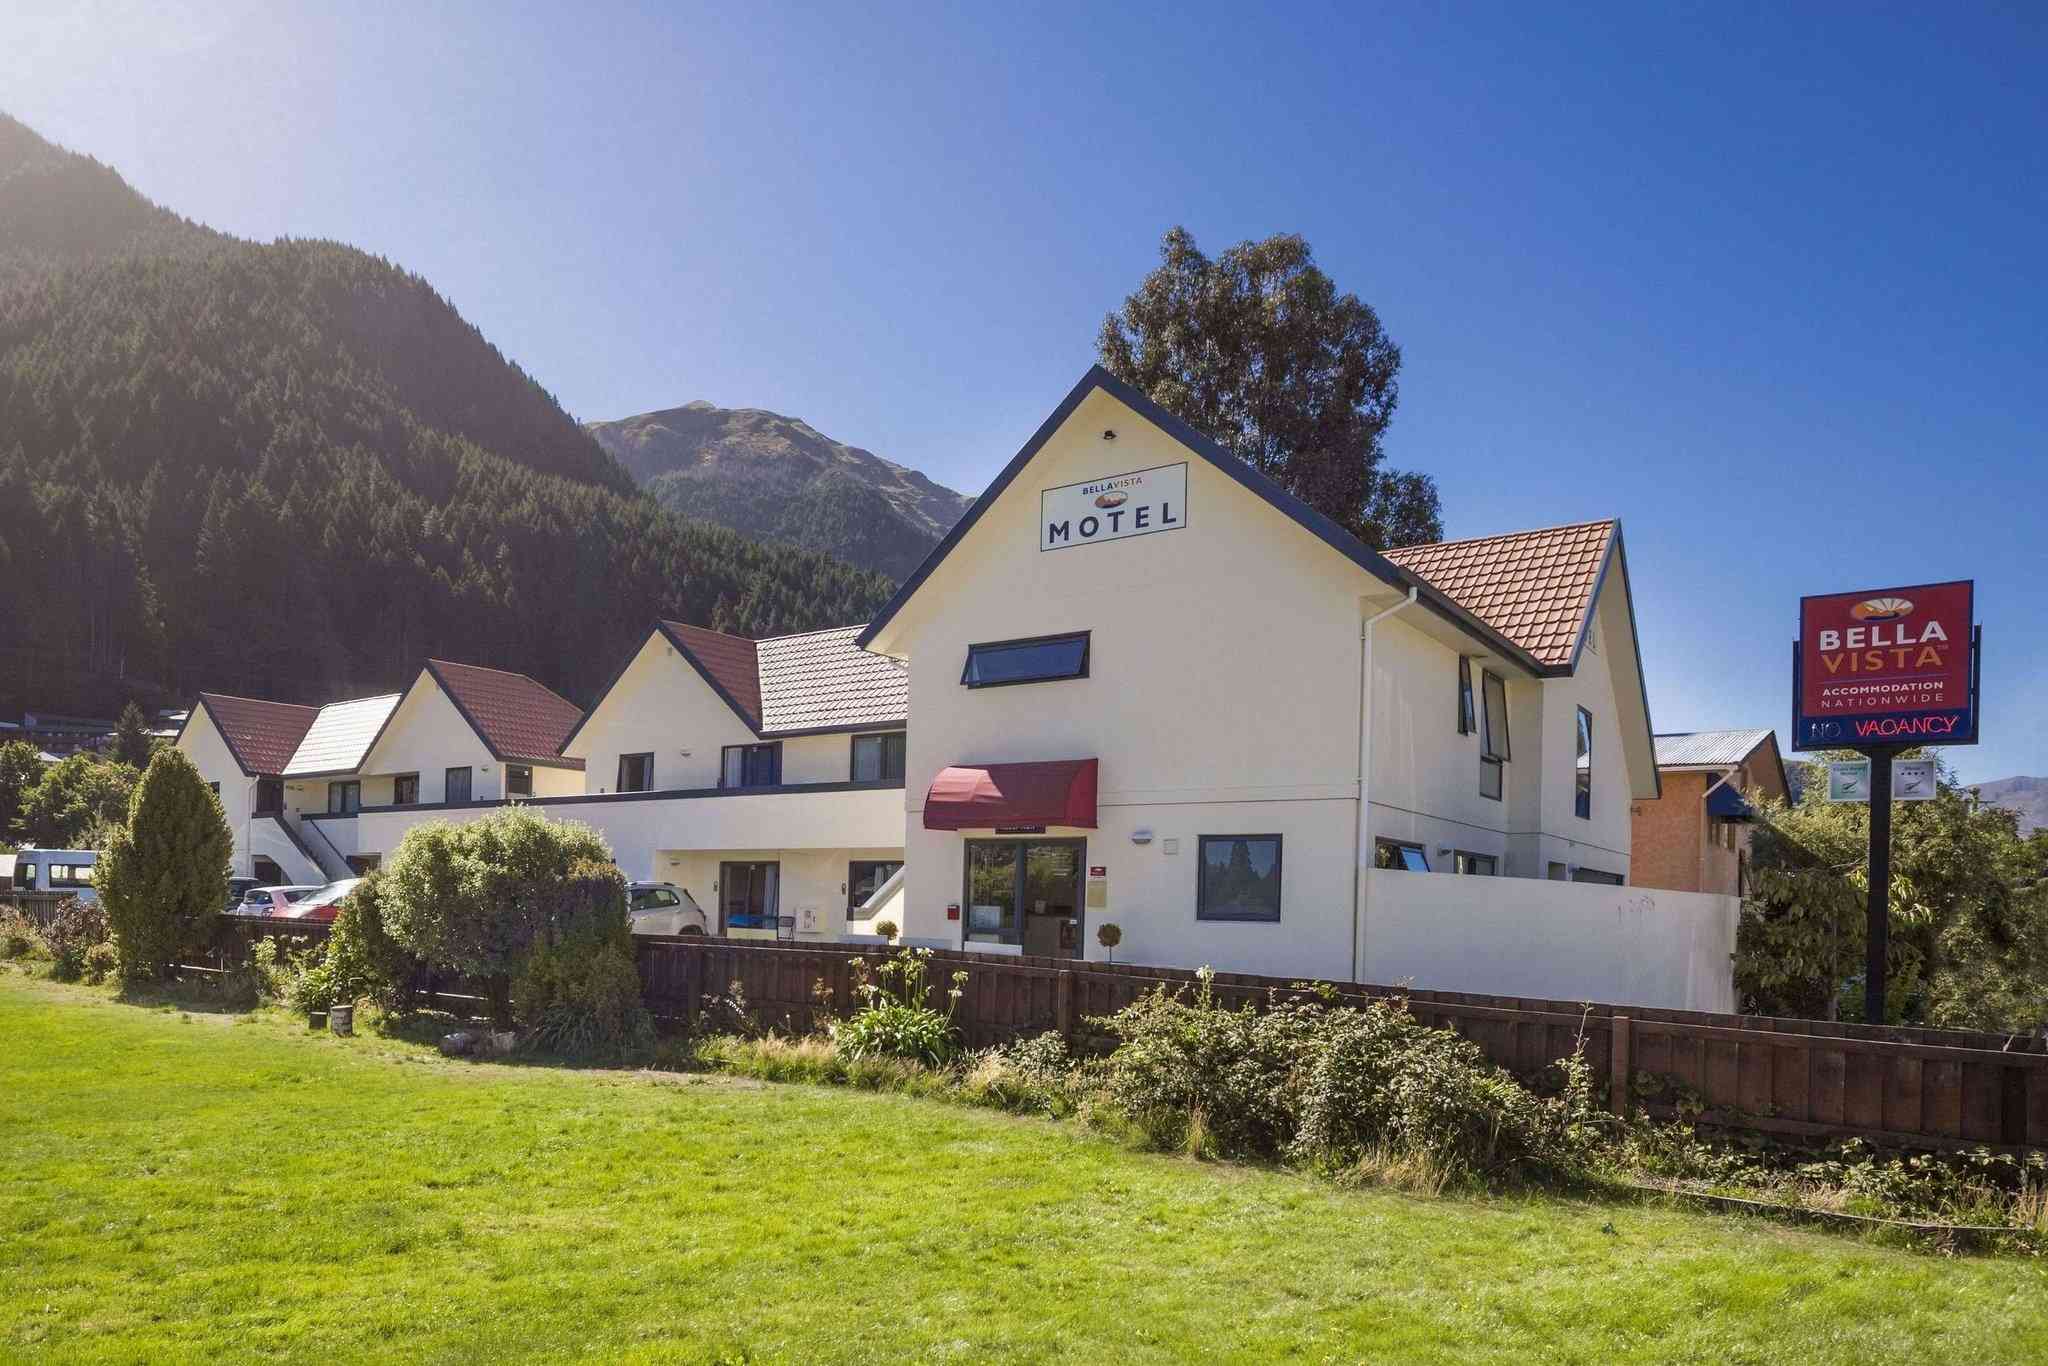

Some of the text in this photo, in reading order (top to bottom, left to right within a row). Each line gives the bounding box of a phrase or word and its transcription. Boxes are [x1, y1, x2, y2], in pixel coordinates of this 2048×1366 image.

[1049, 502, 1177, 543] MOTEL
[1819, 620, 1948, 651] BELLA
[1821, 646, 1943, 674] VISTA
[1821, 692, 1944, 709] NATIONWIDE
[1822, 681, 1944, 697] ACCOMMODATION
[1855, 714, 1960, 737] VACANCY
